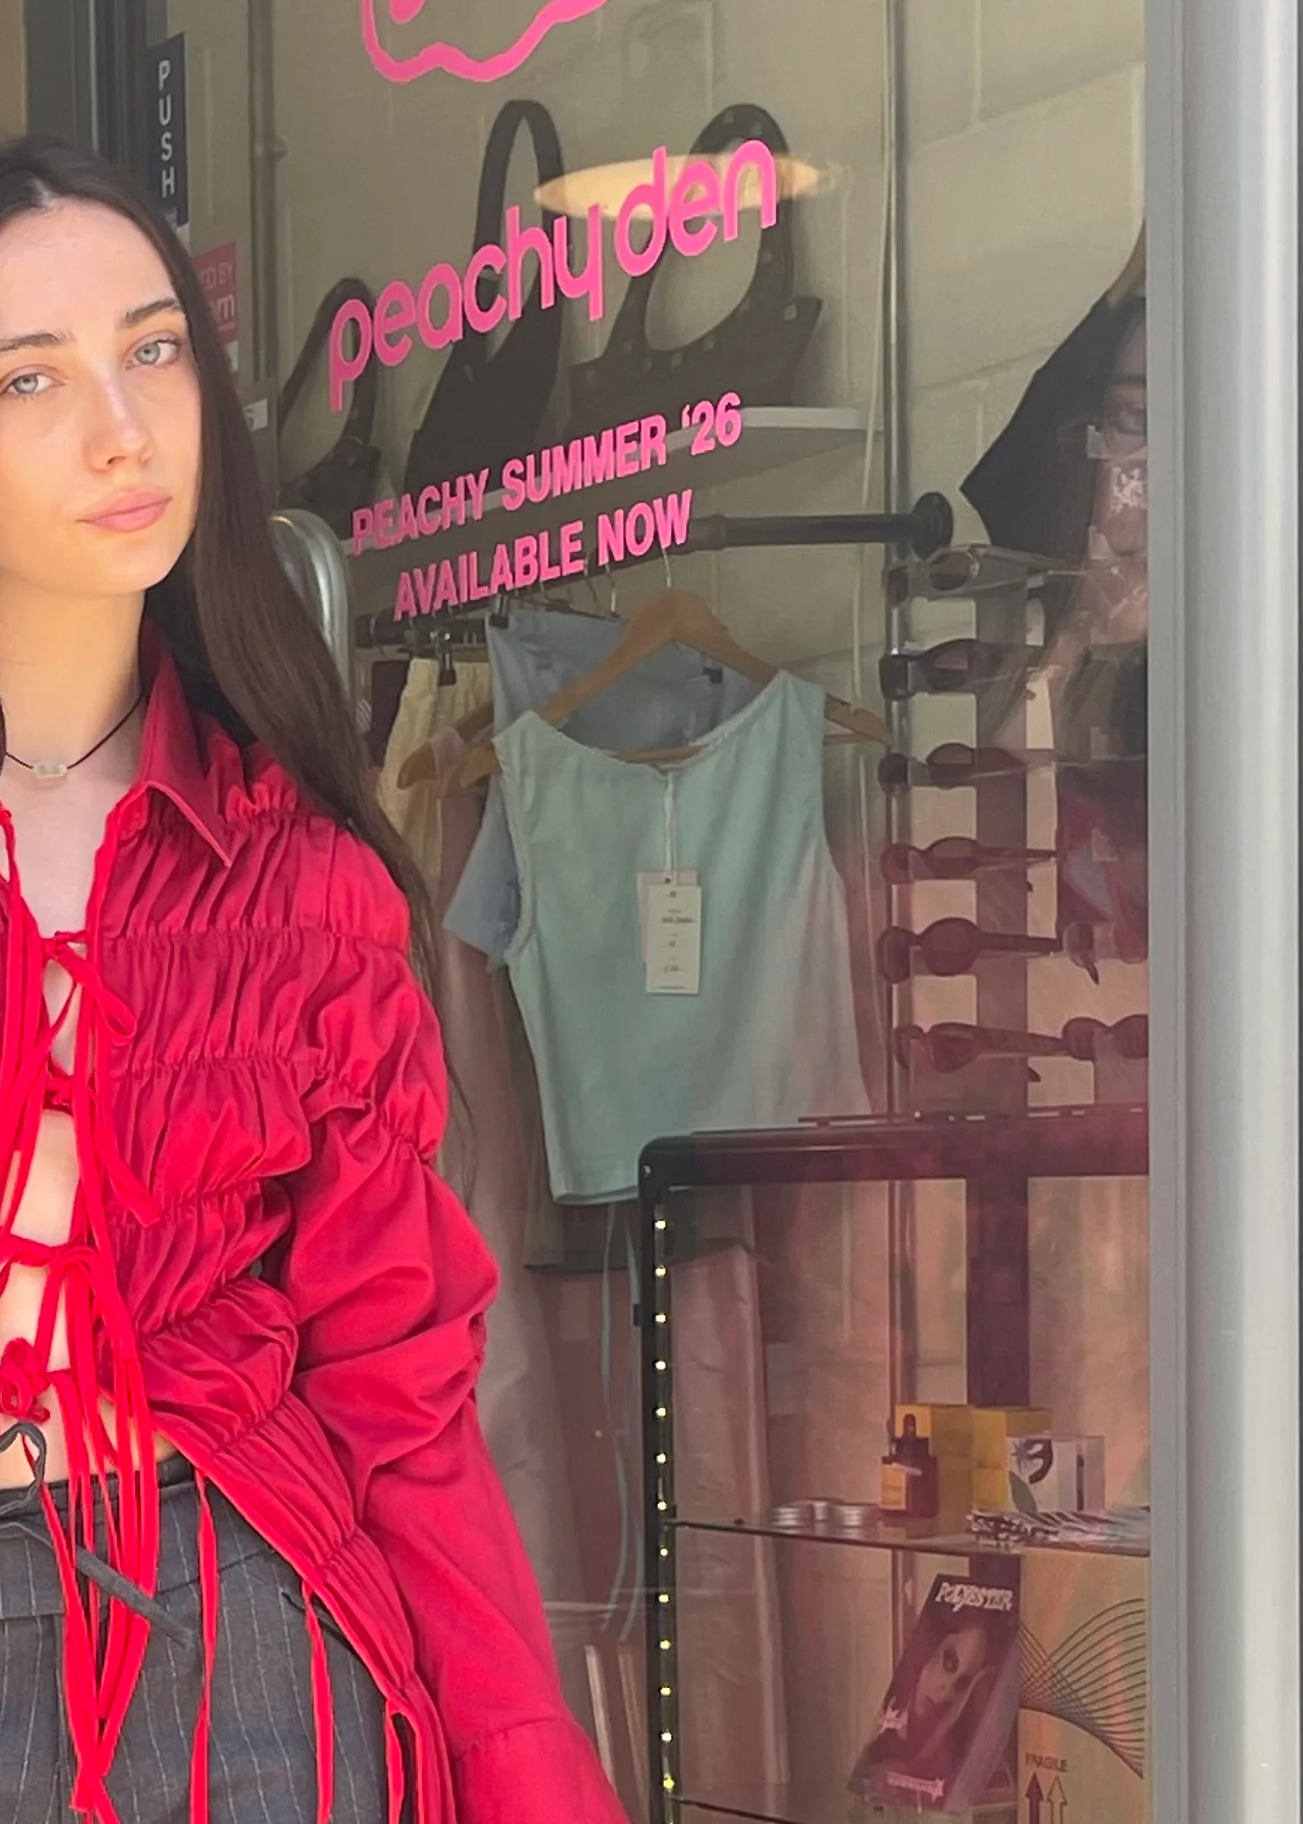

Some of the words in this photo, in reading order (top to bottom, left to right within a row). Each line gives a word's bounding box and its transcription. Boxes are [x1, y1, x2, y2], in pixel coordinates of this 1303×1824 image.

[158, 59, 175, 199] PUSH
[329, 204, 604, 412] peachy
[614, 139, 777, 277] den
[352, 468, 490, 556] PEACHY
[502, 414, 667, 511] SUMMER
[393, 520, 585, 621] AVAILABLE
[597, 488, 693, 566] NOW
